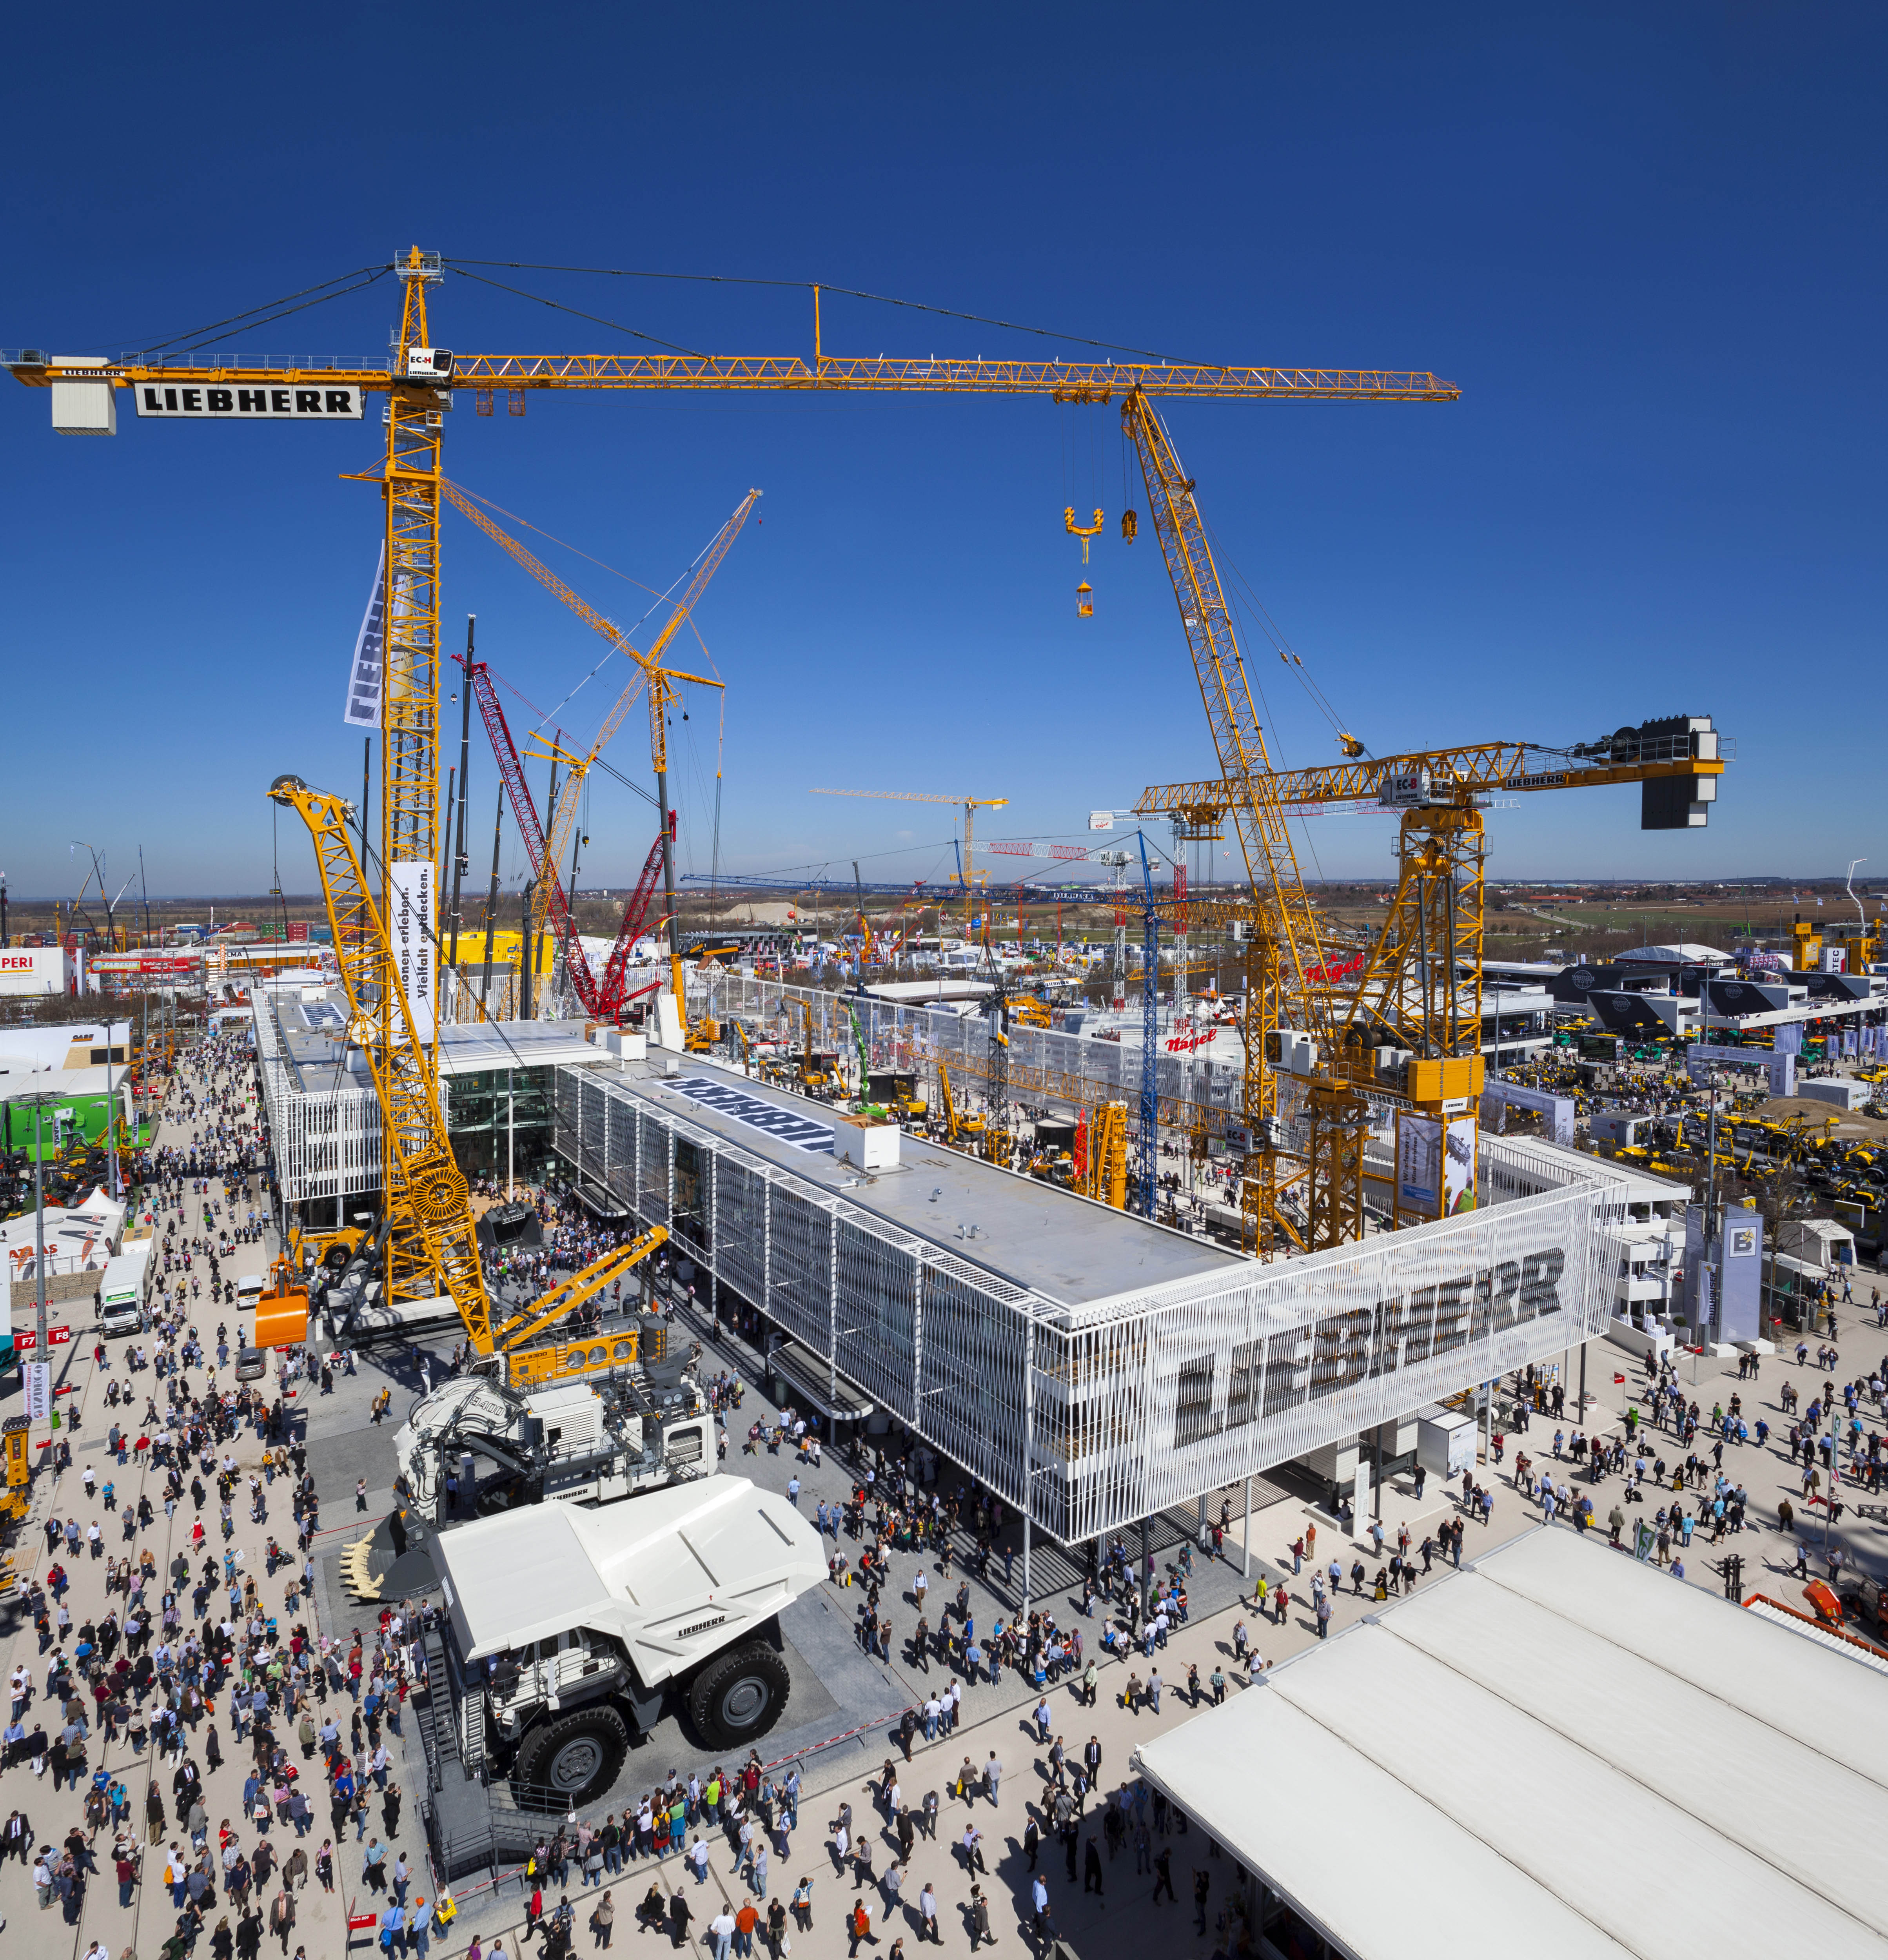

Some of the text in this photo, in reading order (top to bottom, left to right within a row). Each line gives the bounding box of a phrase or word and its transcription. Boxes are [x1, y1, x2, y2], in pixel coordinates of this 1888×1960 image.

[143, 388, 352, 413] LIEBHERR
[1396, 777, 1417, 790] EC-B
[1507, 774, 1564, 787] LIEBHERR
[398, 887, 409, 944] erleben.
[2, 956, 33, 968] PERI
[1302, 953, 1365, 984] Nagel
[417, 948, 428, 999] Vielfalt
[1165, 1028, 1217, 1053] Nagel
[1271, 1064, 1291, 1073] LIEBHERR
[1352, 1088, 1412, 1109] LIEBHERR
[1227, 1129, 1245, 1143] EC-B
[503, 1213, 525, 1223] LIEBHERR
[22, 1336, 35, 1346] F7
[56, 1331, 69, 1341] F8
[610, 1332, 637, 1344] LIEBHERR
[1176, 1247, 1566, 1448] LIEBHERR
[470, 1394, 506, 1417] 9400
[678, 1615, 725, 1638] LIEBHERR
